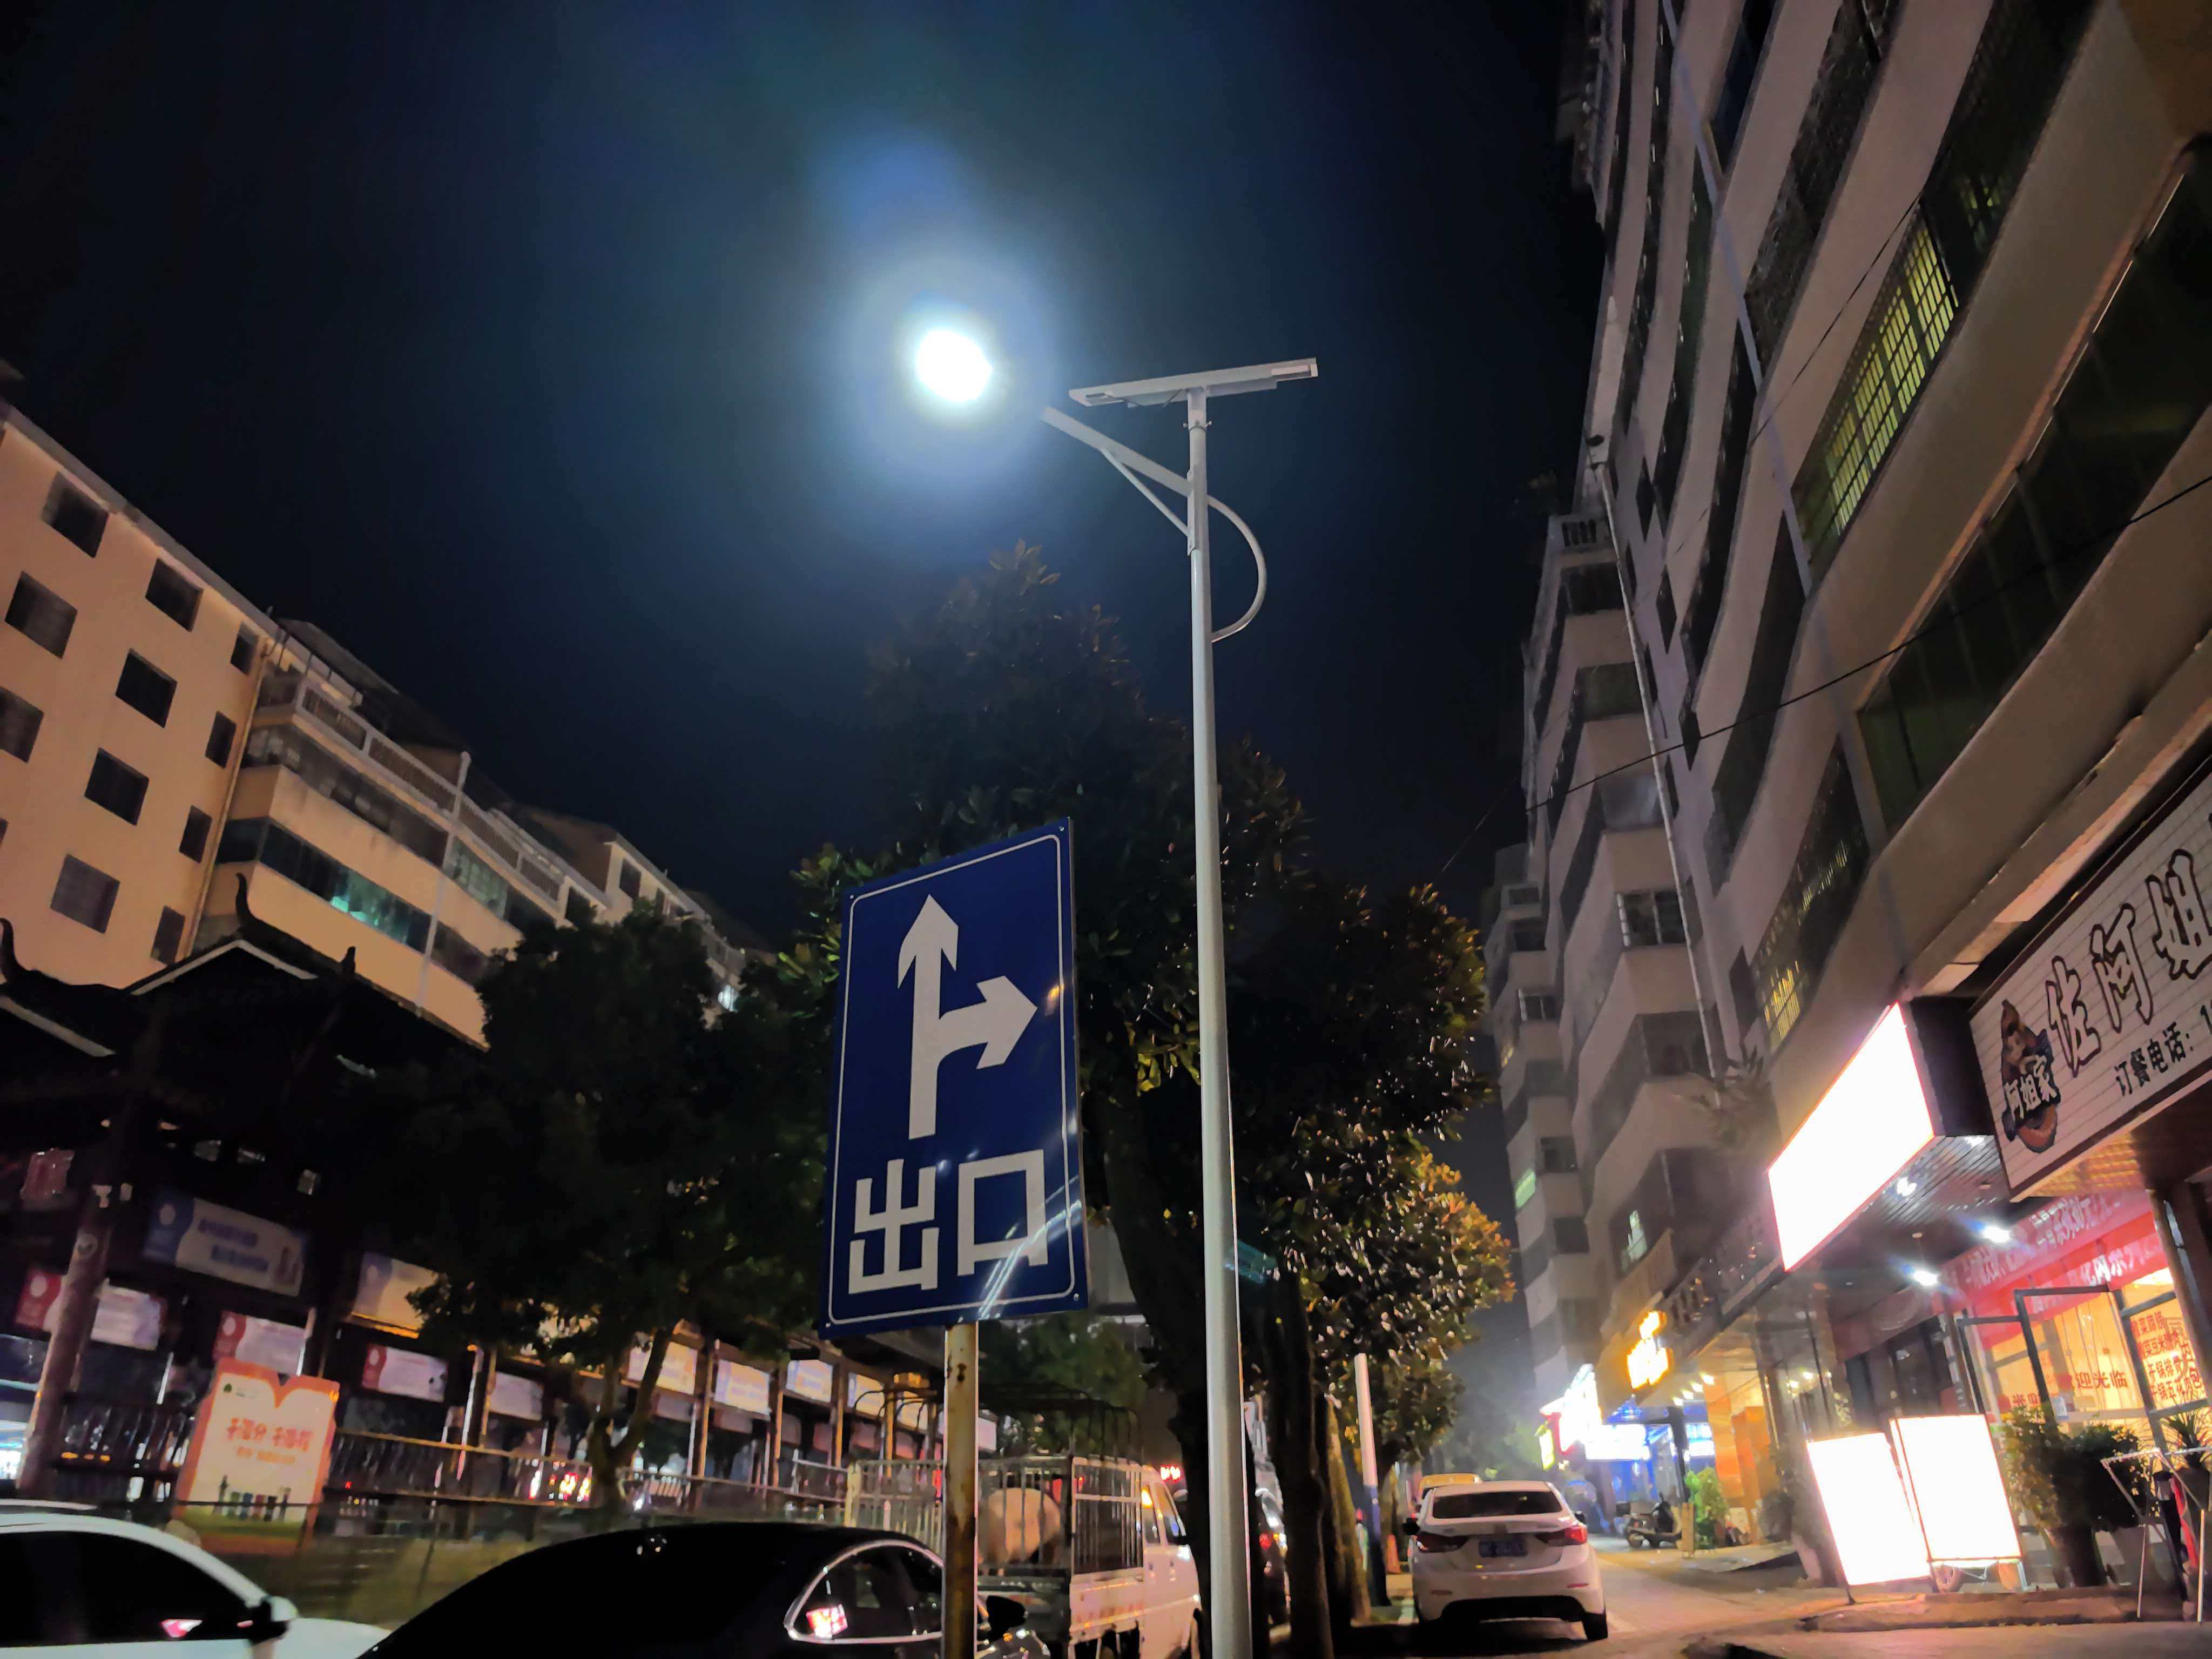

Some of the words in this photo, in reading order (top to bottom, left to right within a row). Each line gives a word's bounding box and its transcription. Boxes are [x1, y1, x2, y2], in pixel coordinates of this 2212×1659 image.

[2004, 1054, 2057, 1121] 阿姐家
[2114, 999, 2212, 1096] 订餐电话：1
[848, 1149, 1049, 1294] 出口
